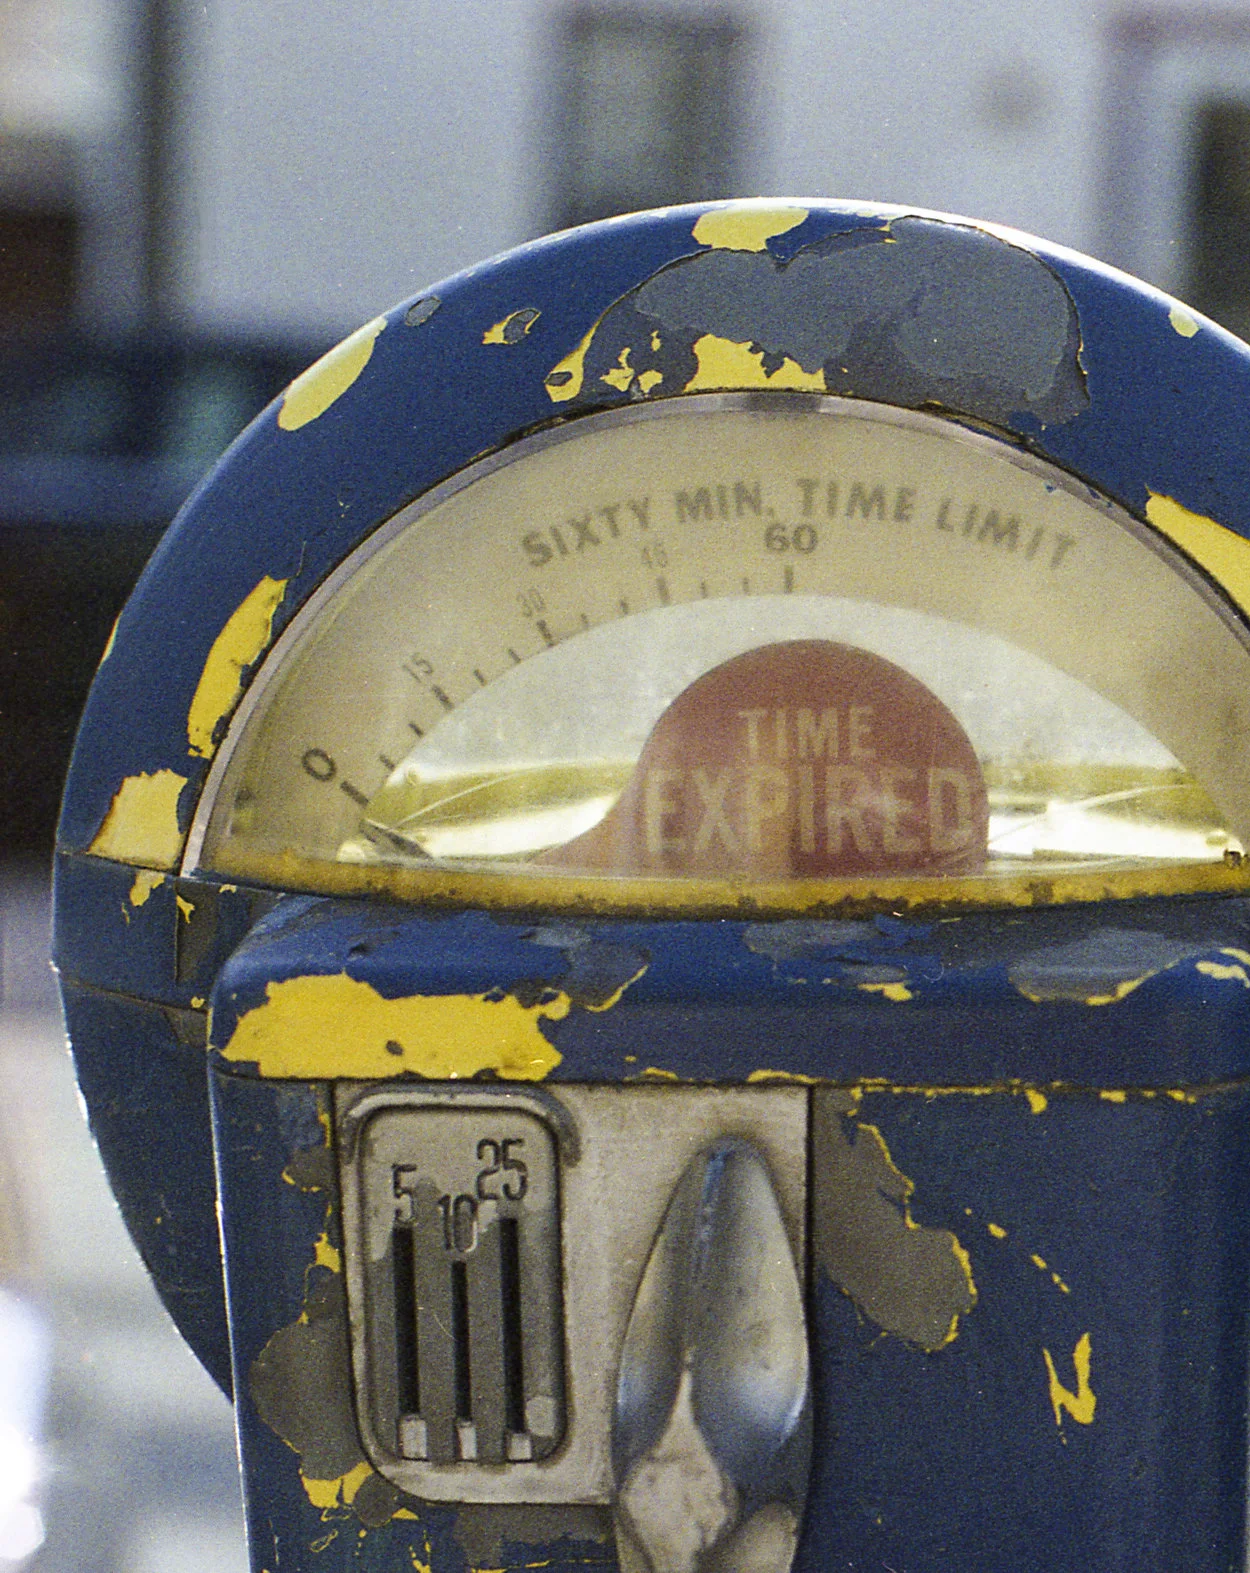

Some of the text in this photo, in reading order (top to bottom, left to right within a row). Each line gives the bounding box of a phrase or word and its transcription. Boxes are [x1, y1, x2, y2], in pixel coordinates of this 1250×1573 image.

[521, 496, 650, 568] SIXTY
[796, 477, 918, 525] TIME
[936, 502, 1077, 569] LIMIT
[763, 522, 819, 555] 60
[402, 651, 435, 684] 15
[738, 706, 877, 762] TIME
[301, 747, 338, 783] 0
[643, 764, 981, 856] EXPIRED
[391, 1162, 417, 1225] 5
[475, 1137, 528, 1201] 25
[439, 1194, 479, 1252] 10
